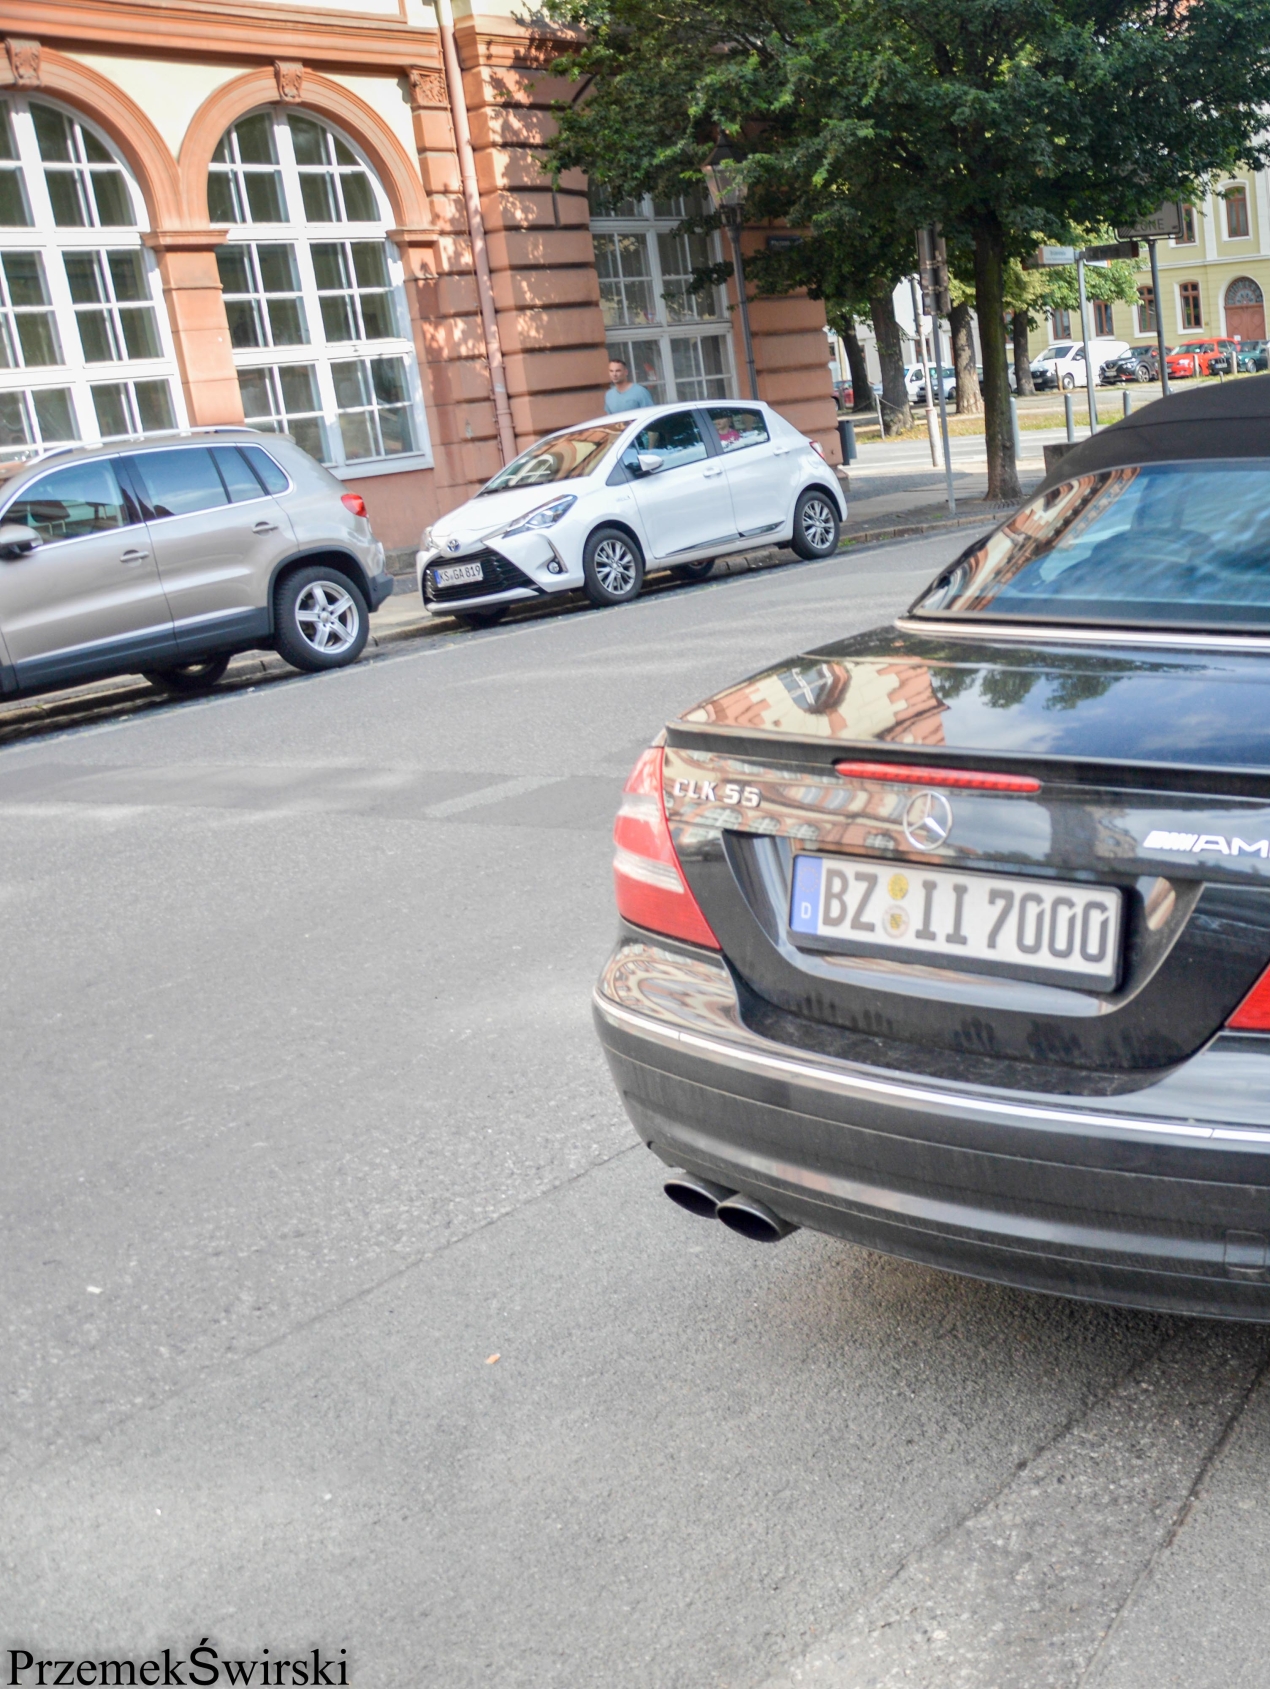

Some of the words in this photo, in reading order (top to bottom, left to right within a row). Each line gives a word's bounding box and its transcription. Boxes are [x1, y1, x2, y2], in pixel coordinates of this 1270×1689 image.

[453, 568, 465, 580] GA
[465, 564, 481, 578] 819
[674, 778, 718, 802] CLK
[723, 784, 761, 807] 55
[801, 902, 811, 919] D
[822, 867, 878, 932] BZ
[987, 887, 1109, 963] 7000
